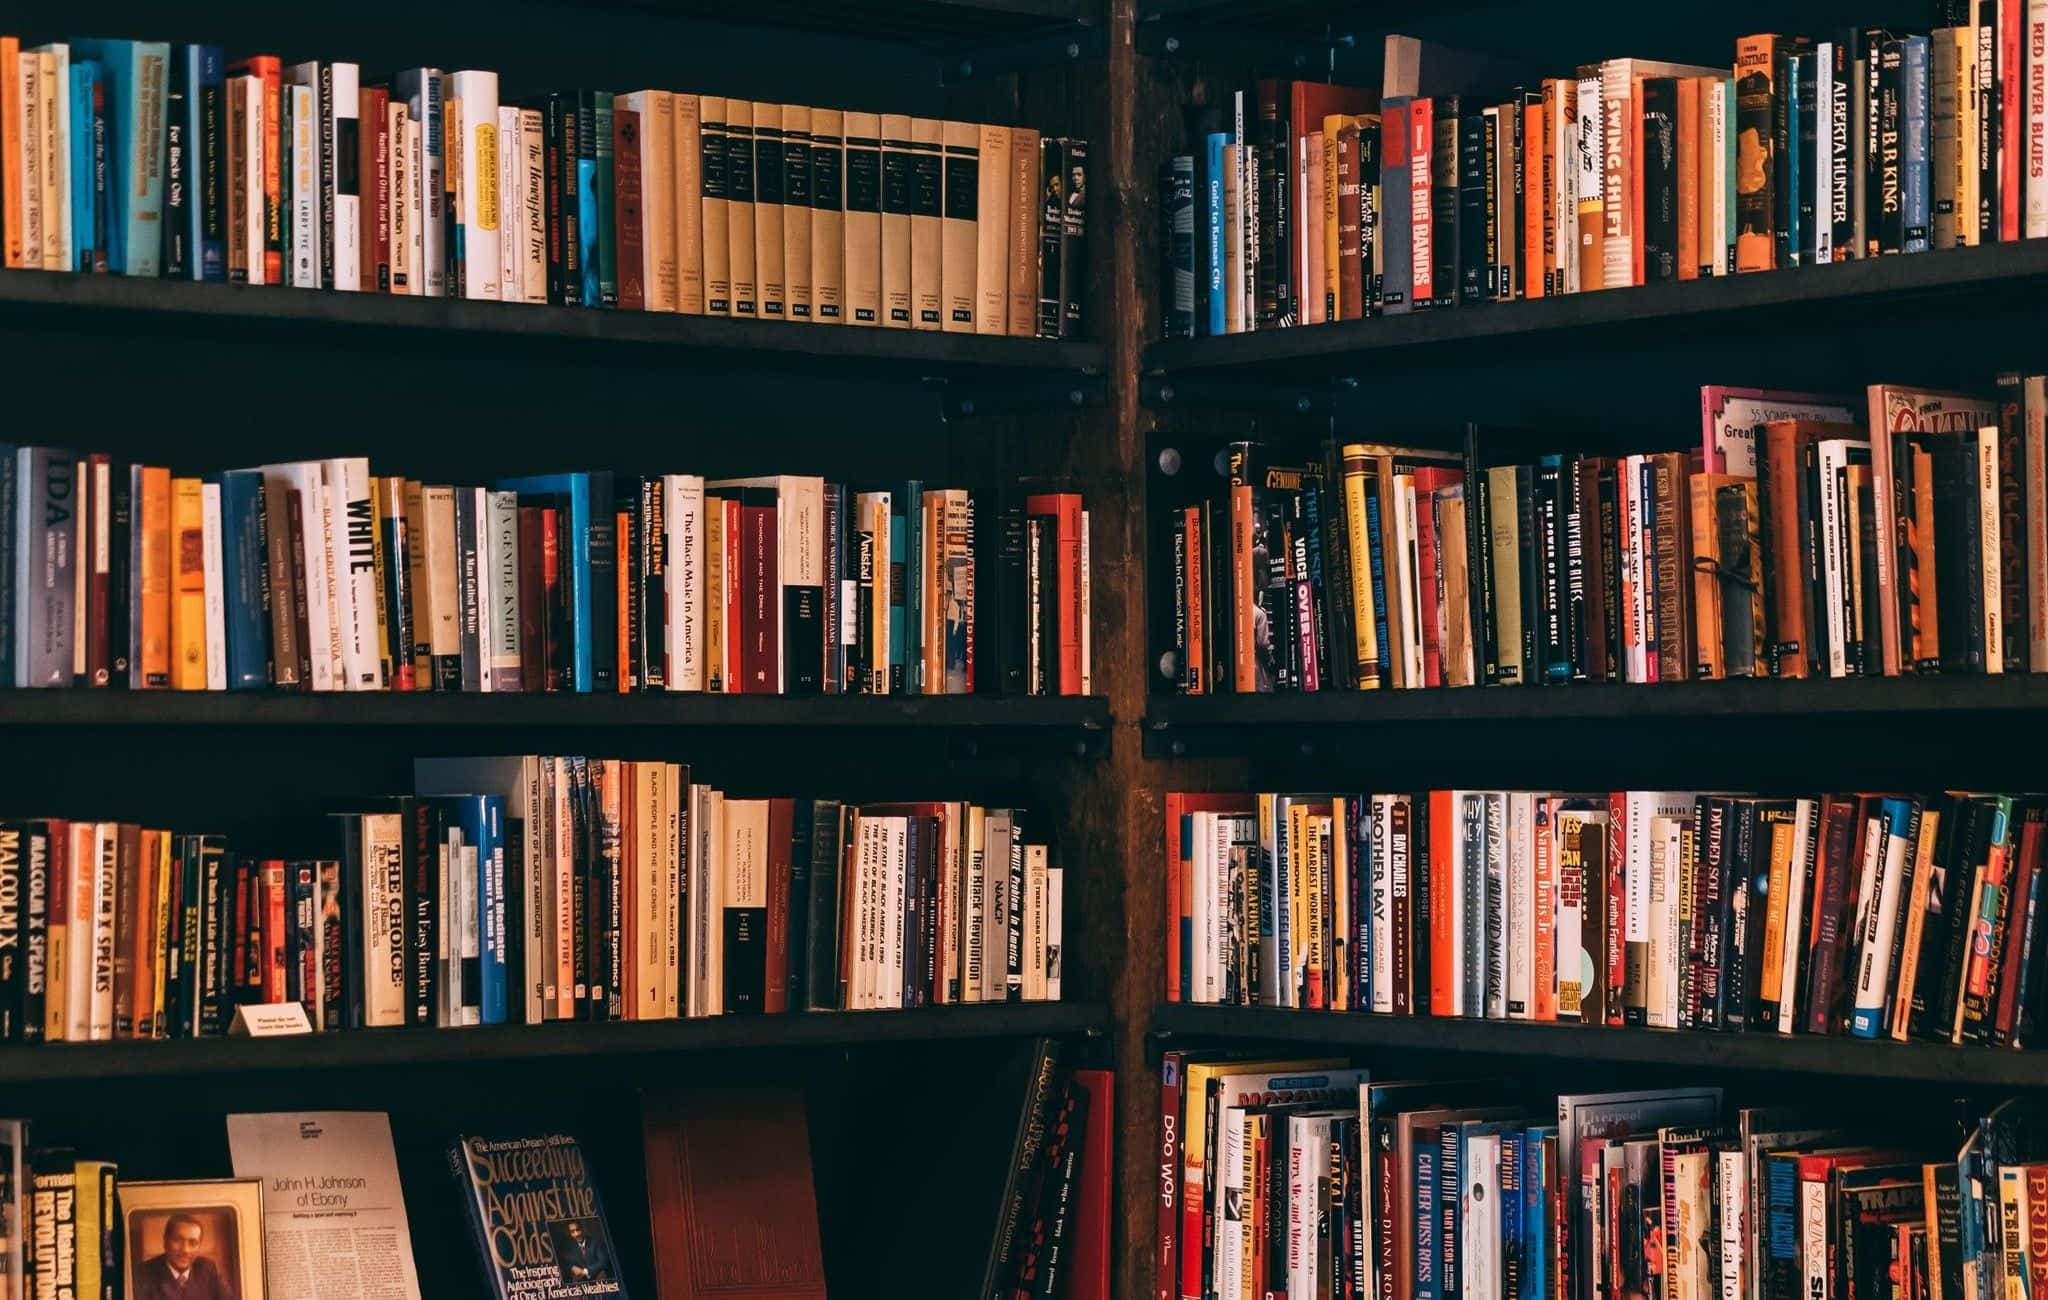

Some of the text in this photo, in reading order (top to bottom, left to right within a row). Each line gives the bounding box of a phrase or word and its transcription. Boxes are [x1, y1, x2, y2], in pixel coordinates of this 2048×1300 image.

[1980, 26, 1992, 89] BESSIE
[322, 67, 330, 140] CONVICTED
[395, 112, 403, 145] Voices
[2032, 23, 2044, 177] RED RIVER BLUES
[95, 116, 104, 191] After the Storm
[170, 126, 181, 207] For Blacks Only
[323, 143, 331, 156] IN
[395, 147, 404, 158] of
[1606, 100, 1622, 237] SWING SHIFT
[1833, 81, 1847, 223] ALBERTA HUNTER
[300, 200, 308, 229] LARRY
[324, 186, 332, 224] WOMB
[395, 171, 404, 199] Black
[527, 144, 543, 263] The Honey-pod Tree
[1212, 211, 1219, 223] to
[1883, 166, 1897, 213] KING
[396, 201, 404, 234] Nation
[1413, 153, 1429, 286] THE BIG BANDS
[1212, 268, 1220, 290] City
[47, 455, 72, 527] IDA
[346, 499, 376, 574] WHITE
[466, 558, 475, 577] Man
[860, 533, 872, 580] Amistad
[1546, 522, 1555, 558] POWER
[467, 578, 475, 606] Called
[684, 512, 694, 664] The Black Male In America
[1294, 537, 1310, 636] VOICE OVER
[1547, 563, 1555, 575] OF
[1548, 579, 1557, 610] BLACK
[467, 607, 476, 634] White
[1550, 615, 1558, 646] MUSIC
[1278, 820, 1288, 854] JAMES
[1372, 801, 1385, 921] BROTHER RAY
[1392, 833, 1407, 898] RAY CHARLES
[1706, 807, 1723, 904] DIVIDED SOUL
[0, 830, 20, 948] MALCOLM X
[494, 847, 506, 964] Militant Mediator
[994, 880, 1004, 925] NAACP
[1248, 868, 1260, 945] BELAFONTE
[1262, 847, 1272, 930] JAMES BROWN
[1278, 857, 1288, 897] BROWN
[1308, 825, 1319, 965] THE HARDEST WORKING MAN
[1536, 830, 1550, 936] Sammy Davis Jr.
[29, 835, 45, 995] MALCOLM X SPEAKS
[96, 839, 113, 993] MALCOLM X SPEAKS
[387, 845, 403, 988] THE CHOICE:
[561, 872, 569, 968] CREATIVE FIRE
[969, 848, 983, 980] The Black Revolution
[1279, 907, 1289, 936] FEEL
[1609, 895, 1620, 966] Aretha Franklin
[414, 897, 431, 998] An Easy Burden
[1279, 939, 1290, 971] GOOD
[272, 1176, 366, 1193] John H Johnson
[469, 1136, 585, 1186] Succeeding
[1161, 1115, 1175, 1208] DOO WOP
[297, 1192, 349, 1208] of Ebony
[487, 1179, 597, 1234] Against the
[1418, 1154, 1432, 1283] CALL HER MISS ROSS
[2030, 1175, 2048, 1281] PRIDE
[492, 1217, 554, 1269] Odds
[1382, 1219, 1393, 1267] DIANA
[1443, 1208, 1455, 1263] MARY WILSON
